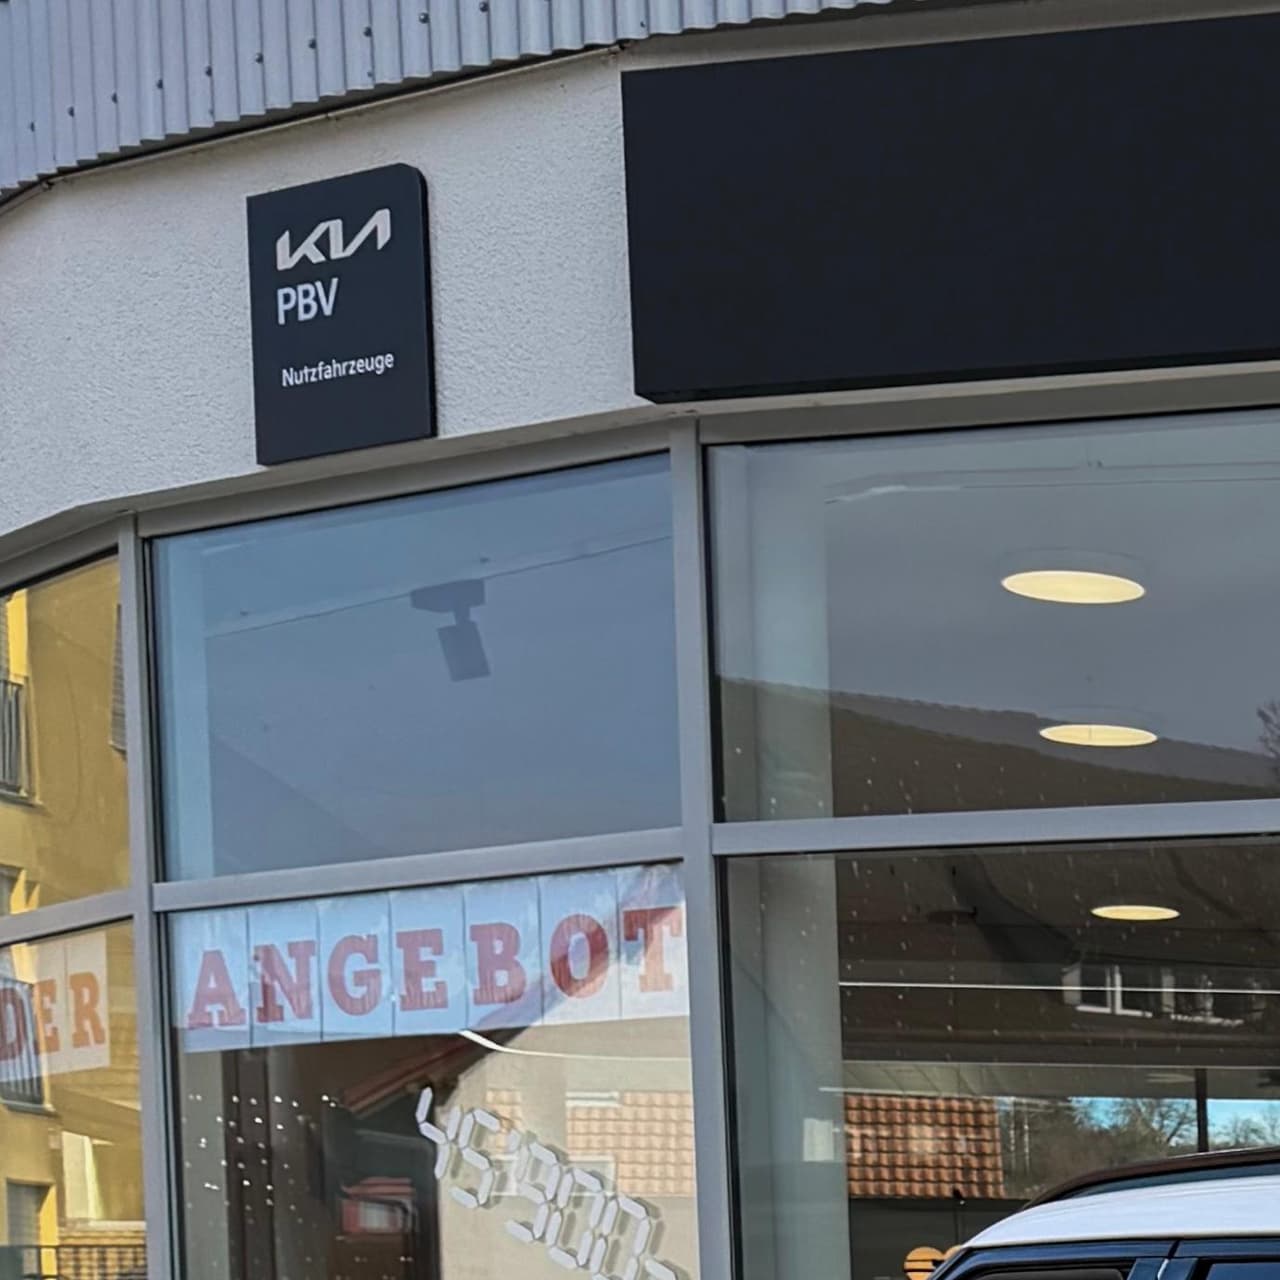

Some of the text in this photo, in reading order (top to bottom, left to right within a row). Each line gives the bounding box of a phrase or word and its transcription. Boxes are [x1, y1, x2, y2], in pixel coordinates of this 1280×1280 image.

[276, 208, 391, 270] KIA
[276, 276, 340, 325] PBV
[281, 351, 395, 388] Nutzfahrzeuge
[187, 906, 684, 1031] ANGEBOT
